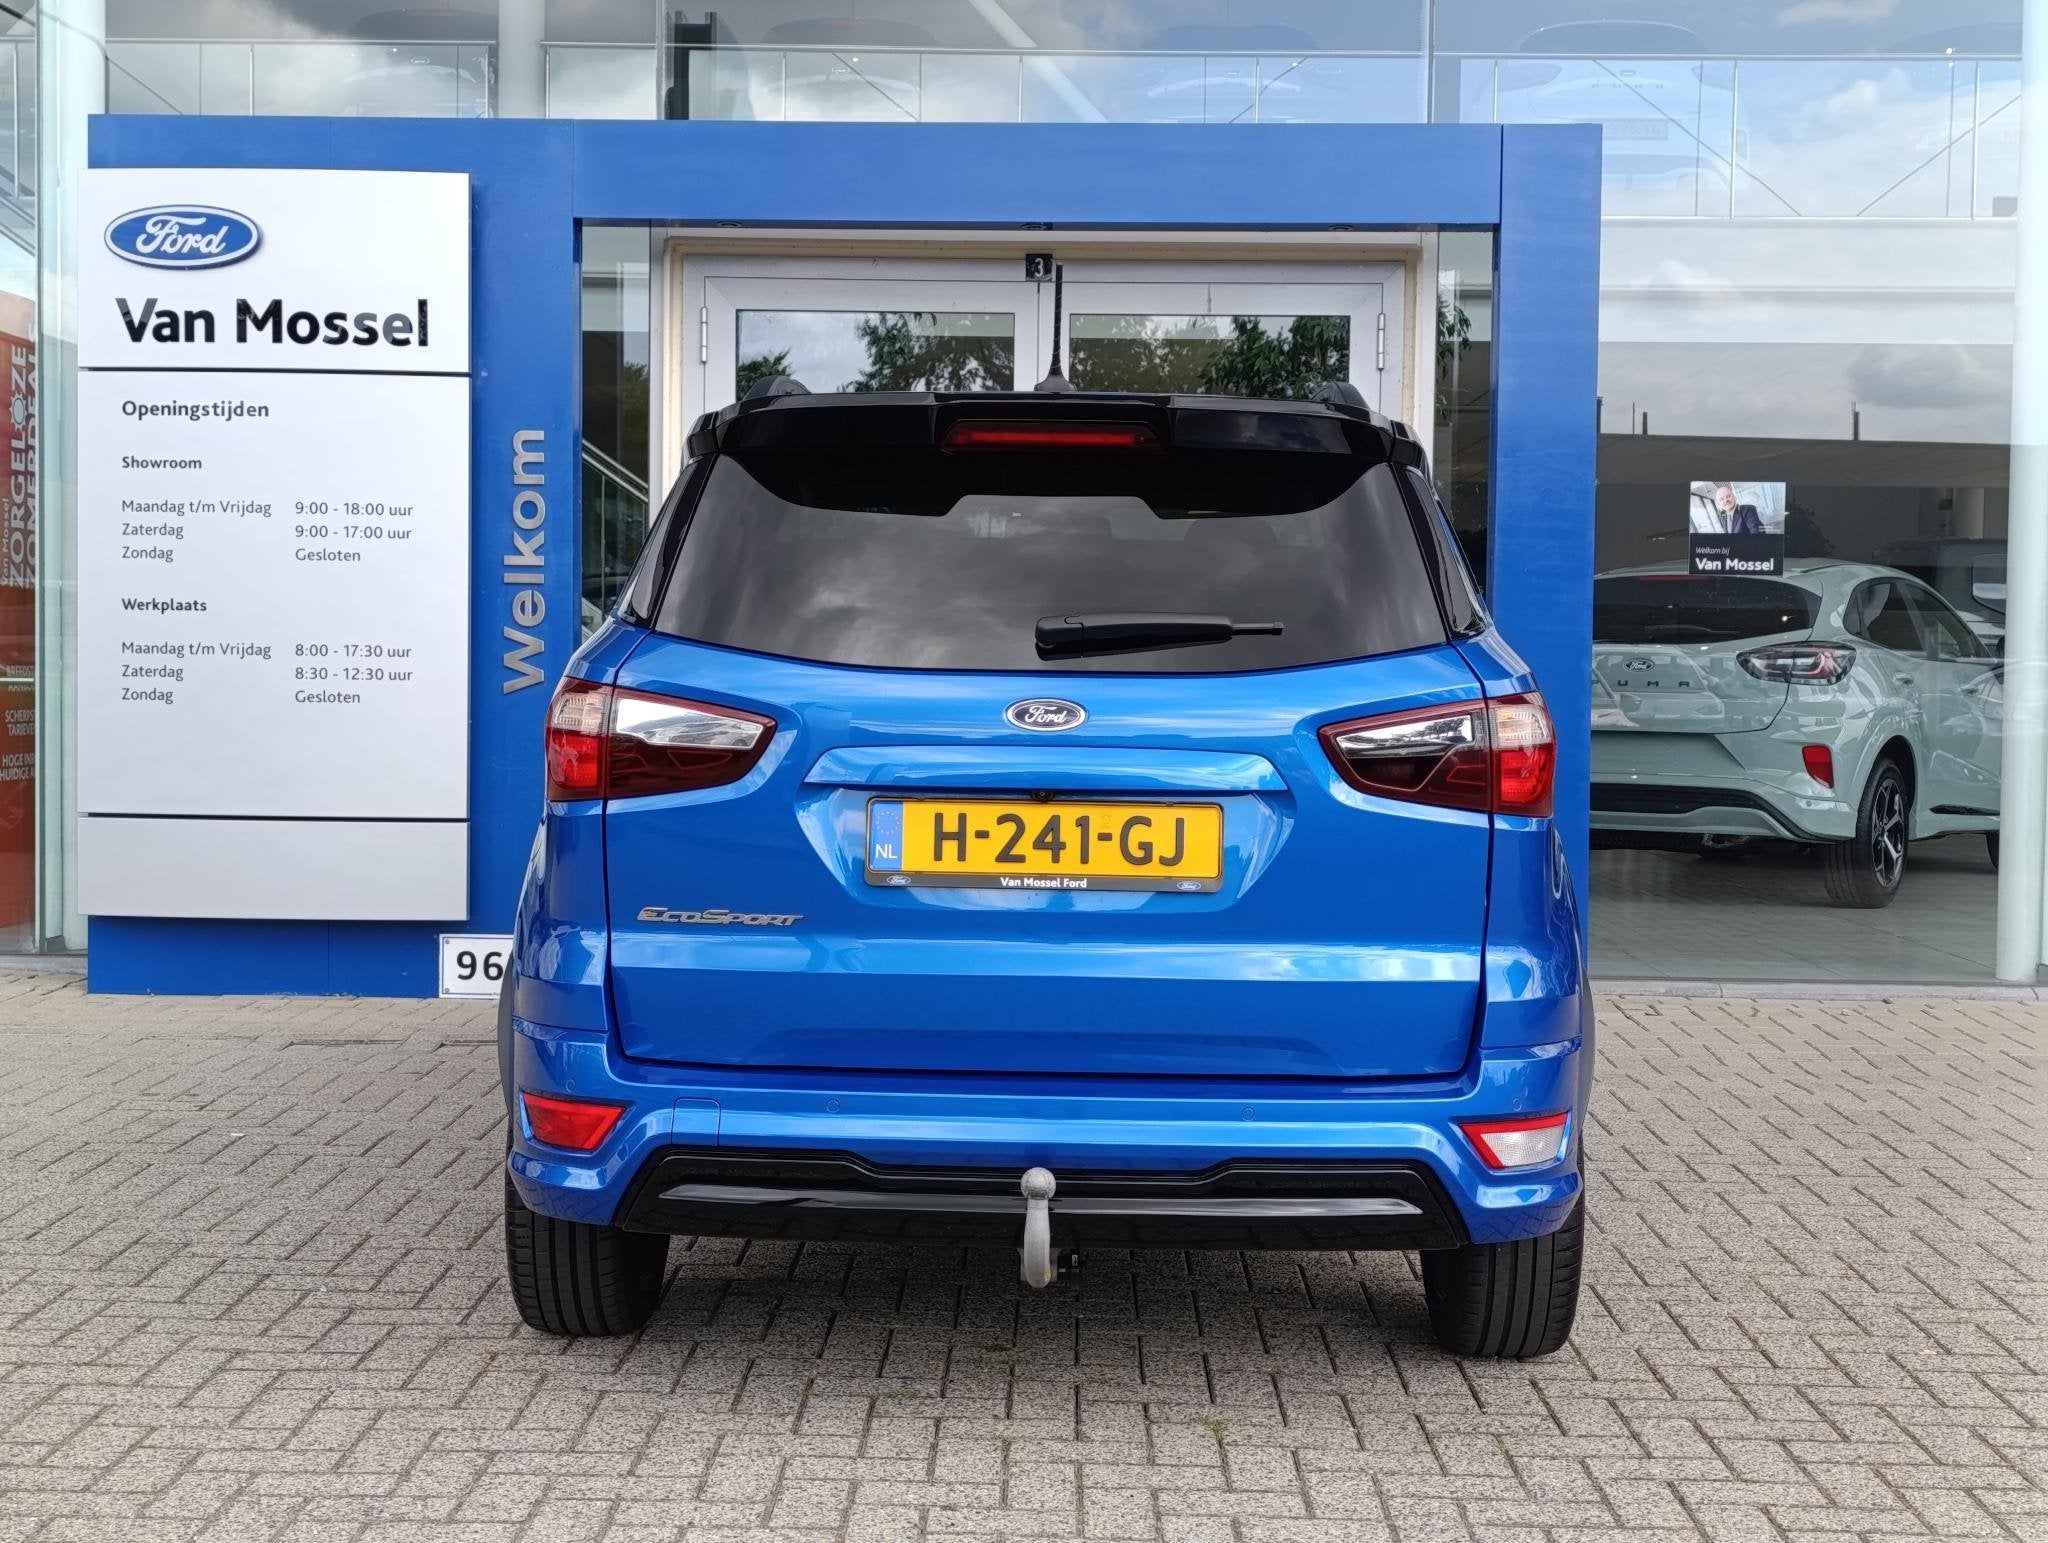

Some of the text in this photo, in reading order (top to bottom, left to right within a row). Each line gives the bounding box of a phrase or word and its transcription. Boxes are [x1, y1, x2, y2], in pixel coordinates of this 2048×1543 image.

[136, 215, 229, 254] Ford
[1034, 257, 1044, 278] 3
[115, 298, 429, 347] Van Mossel
[122, 400, 270, 422] Openingstijden
[121, 455, 203, 470] Showroom
[121, 499, 185, 517] Maandag
[188, 499, 216, 514] t/m
[219, 500, 272, 518] Vrijdag
[295, 501, 329, 515] 9:00
[344, 502, 385, 516] 18:00
[389, 505, 414, 517] uur
[2, 498, 10, 553] Mossel
[121, 522, 184, 540] Zaterdag
[295, 524, 329, 538] 9:00
[344, 525, 383, 539] 17:00
[387, 528, 412, 540] uur
[121, 545, 361, 564] Zondag Gesloten
[503, 429, 546, 695] Welkom
[1695, 557, 1775, 571] Van Mossel
[121, 597, 207, 615] Werkplaats
[121, 641, 185, 659] Maandag
[188, 641, 215, 656] t/m
[219, 642, 272, 660] Vrijdag
[295, 643, 329, 657] 8:00
[343, 644, 383, 658] 17:30
[387, 647, 412, 658] uur
[121, 664, 184, 682] Zaterdag
[295, 666, 329, 680] 8:30
[343, 667, 385, 681] 12:30
[388, 670, 413, 681] uur
[121, 687, 361, 705] Zondag Gesloten
[932, 811, 1186, 867] H-241-GJ
[874, 844, 898, 860] NL
[1000, 876, 1022, 888] Van
[1023, 877, 1061, 888] Mossel
[1063, 878, 1088, 889] Ford
[456, 950, 504, 981] 96
